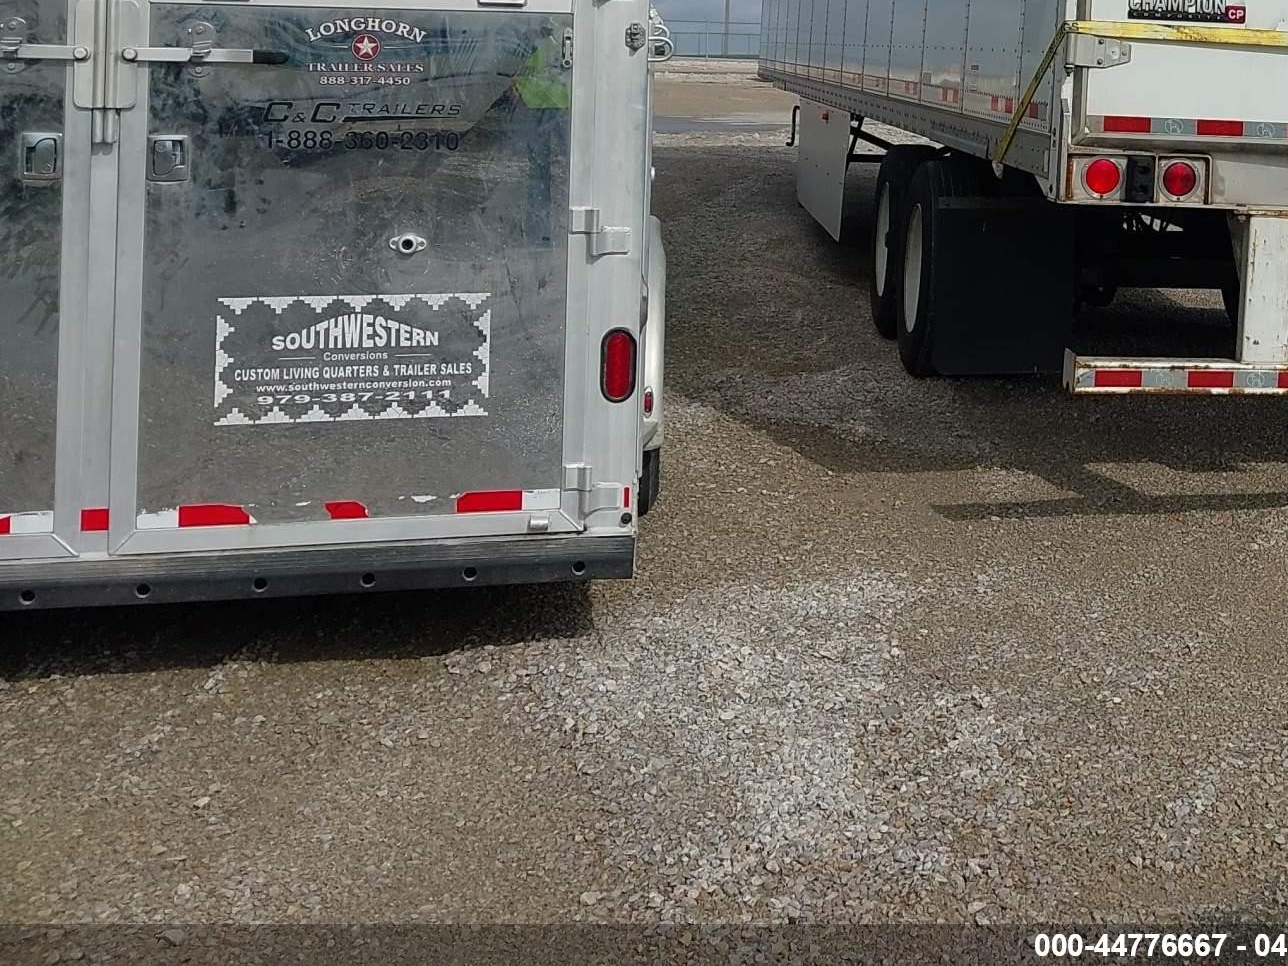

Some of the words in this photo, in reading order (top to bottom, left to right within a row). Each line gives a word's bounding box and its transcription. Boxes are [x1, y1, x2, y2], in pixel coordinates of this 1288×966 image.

[1228, 9, 1244, 19] CP
[305, 17, 427, 43] LONGHORN
[306, 62, 376, 73] TRAILER
[377, 63, 425, 73] SALES
[319, 76, 411, 85] 888-317-4450
[349, 103, 462, 116] TRAILERS
[265, 130, 460, 151] 1-888-360-2310
[271, 313, 439, 351] SOUTHWESTERN
[323, 351, 388, 362] Conversions
[234, 368, 280, 381] CUSTOM
[283, 367, 320, 380] LIVING
[322, 365, 379, 379] QUARTERS
[382, 365, 390, 377] &
[393, 364, 437, 376] TRAILER
[440, 362, 472, 375] SALES
[256, 378, 451, 394] www.southwesternconversion.com
[257, 389, 451, 405] 979-387-2111
